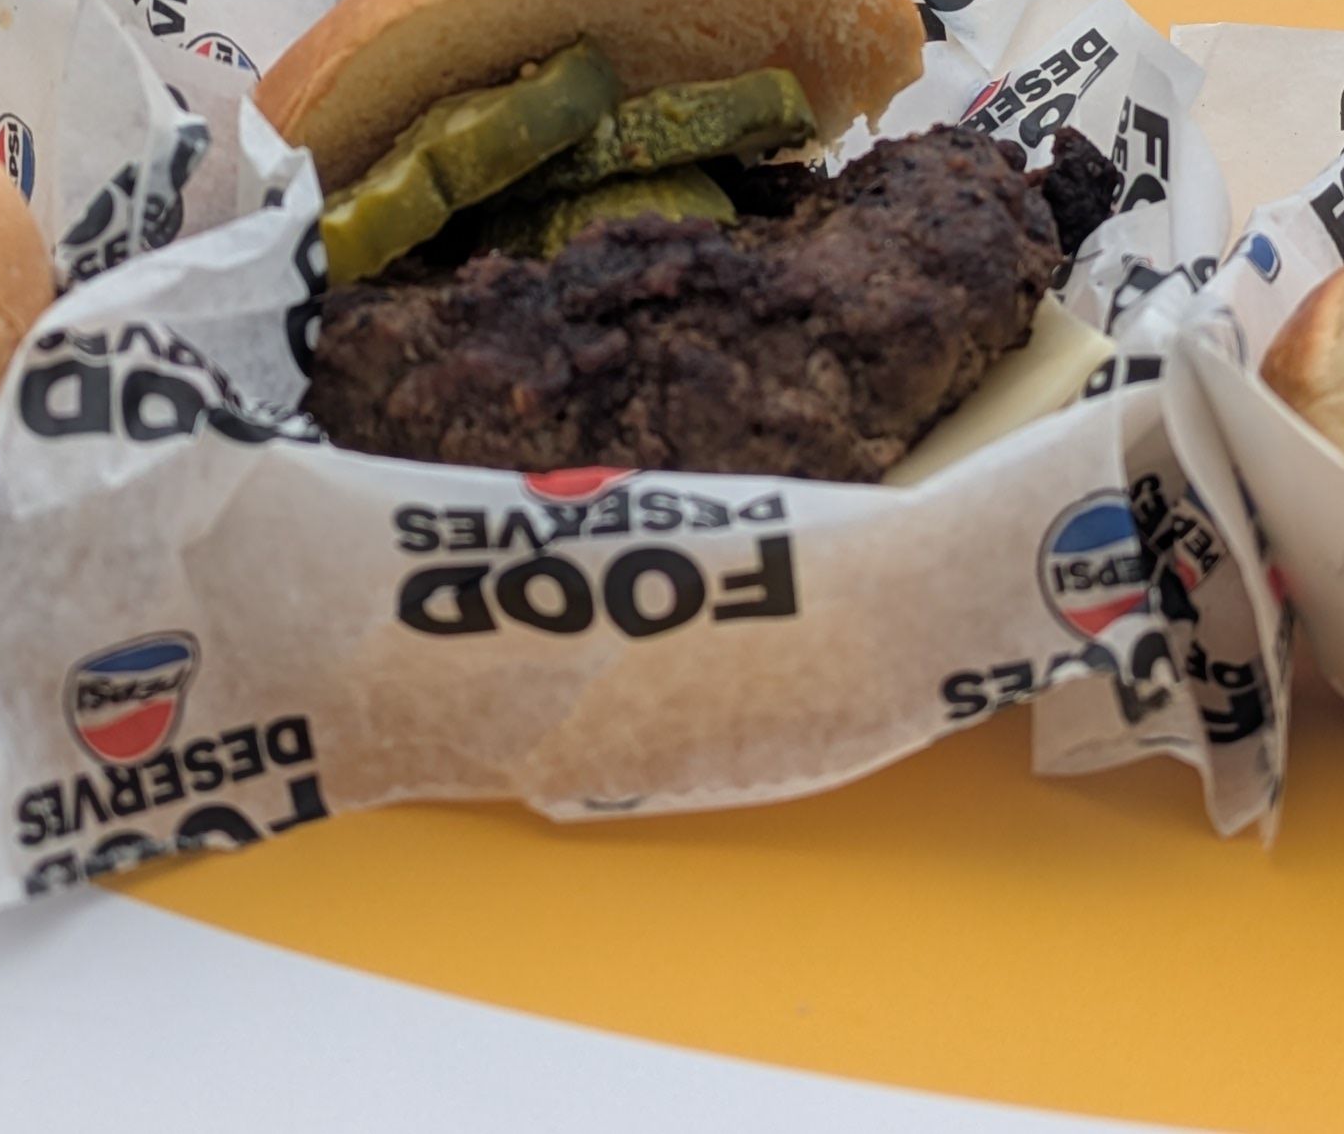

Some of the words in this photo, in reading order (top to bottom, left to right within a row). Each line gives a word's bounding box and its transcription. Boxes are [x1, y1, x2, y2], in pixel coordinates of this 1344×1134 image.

[8, 122, 20, 186] PSI
[394, 487, 786, 553] DESERVES
[399, 534, 797, 638] FOOD
[18, 716, 314, 844] DESERVES
